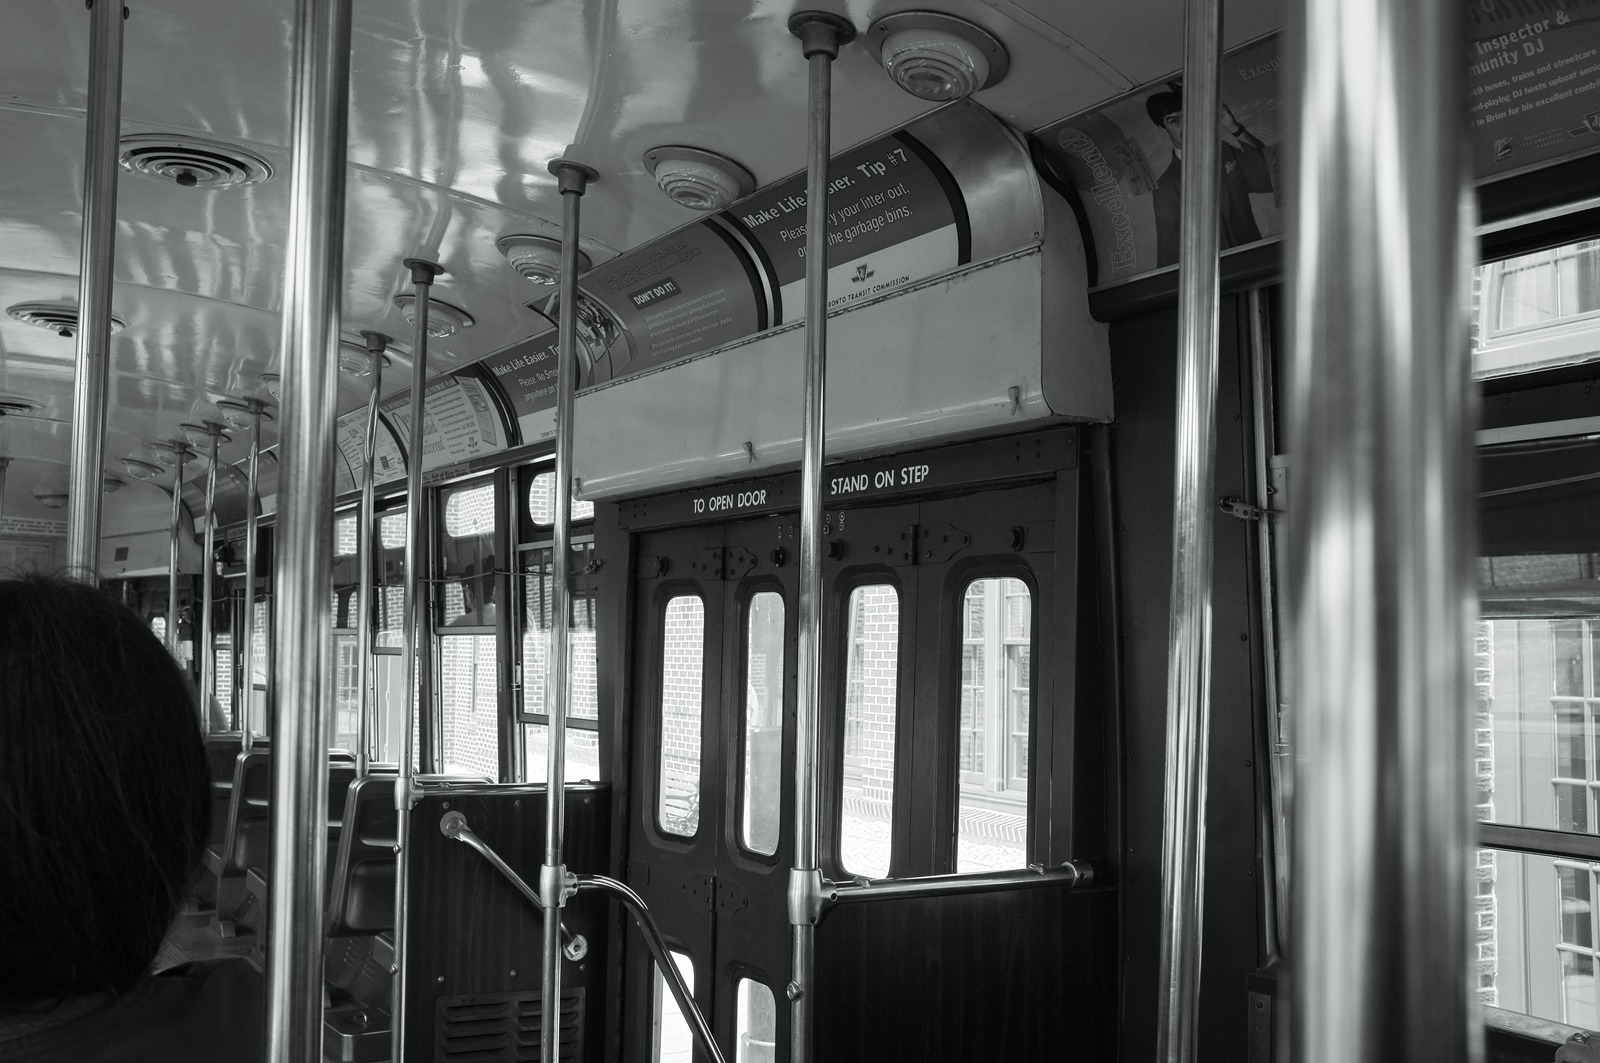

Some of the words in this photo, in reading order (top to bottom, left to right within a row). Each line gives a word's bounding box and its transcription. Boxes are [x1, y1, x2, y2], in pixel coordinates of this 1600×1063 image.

[1474, 19, 1549, 55] Inspector
[1556, 10, 1570, 25] &
[1469, 50, 1518, 76] munity
[1523, 38, 1544, 56] DJ
[1485, 80, 1510, 91] buses,
[1512, 71, 1535, 83] trains
[1536, 63, 1551, 74] and
[1553, 49, 1597, 68] streetcars
[1486, 111, 1507, 123] Brian
[1508, 107, 1520, 116] for
[1521, 102, 1534, 112] his
[1535, 89, 1573, 107] excellent
[1574, 79, 1600, 94] contri
[1512, 89, 1522, 98] DJ
[1523, 82, 1547, 95] hosts
[1549, 71, 1577, 86] upbeat
[742, 207, 780, 228] Make
[777, 196, 807, 213] Life
[856, 162, 887, 178] Tip
[886, 148, 908, 166] #7
[779, 223, 807, 243] Pleas
[837, 202, 861, 223] your
[859, 192, 886, 210] litter
[887, 182, 911, 199] out,
[844, 215, 885, 243] garbage
[884, 205, 913, 223] bins.
[633, 290, 655, 305] DON'T
[653, 286, 666, 297] DO
[663, 281, 676, 293] IT!
[828, 296, 847, 308] RONTO
[848, 287, 871, 301] TRANSIT
[872, 275, 910, 293] COMMISSION
[492, 364, 513, 377] Make
[510, 358, 526, 371] Life
[523, 351, 549, 365] Easier.
[536, 372, 546, 382] No
[693, 498, 705, 514] TO
[708, 494, 734, 512] OPEN
[737, 489, 767, 508] DOOR
[830, 474, 869, 495] STAND
[874, 469, 895, 489] ON
[900, 464, 929, 485] STEP
